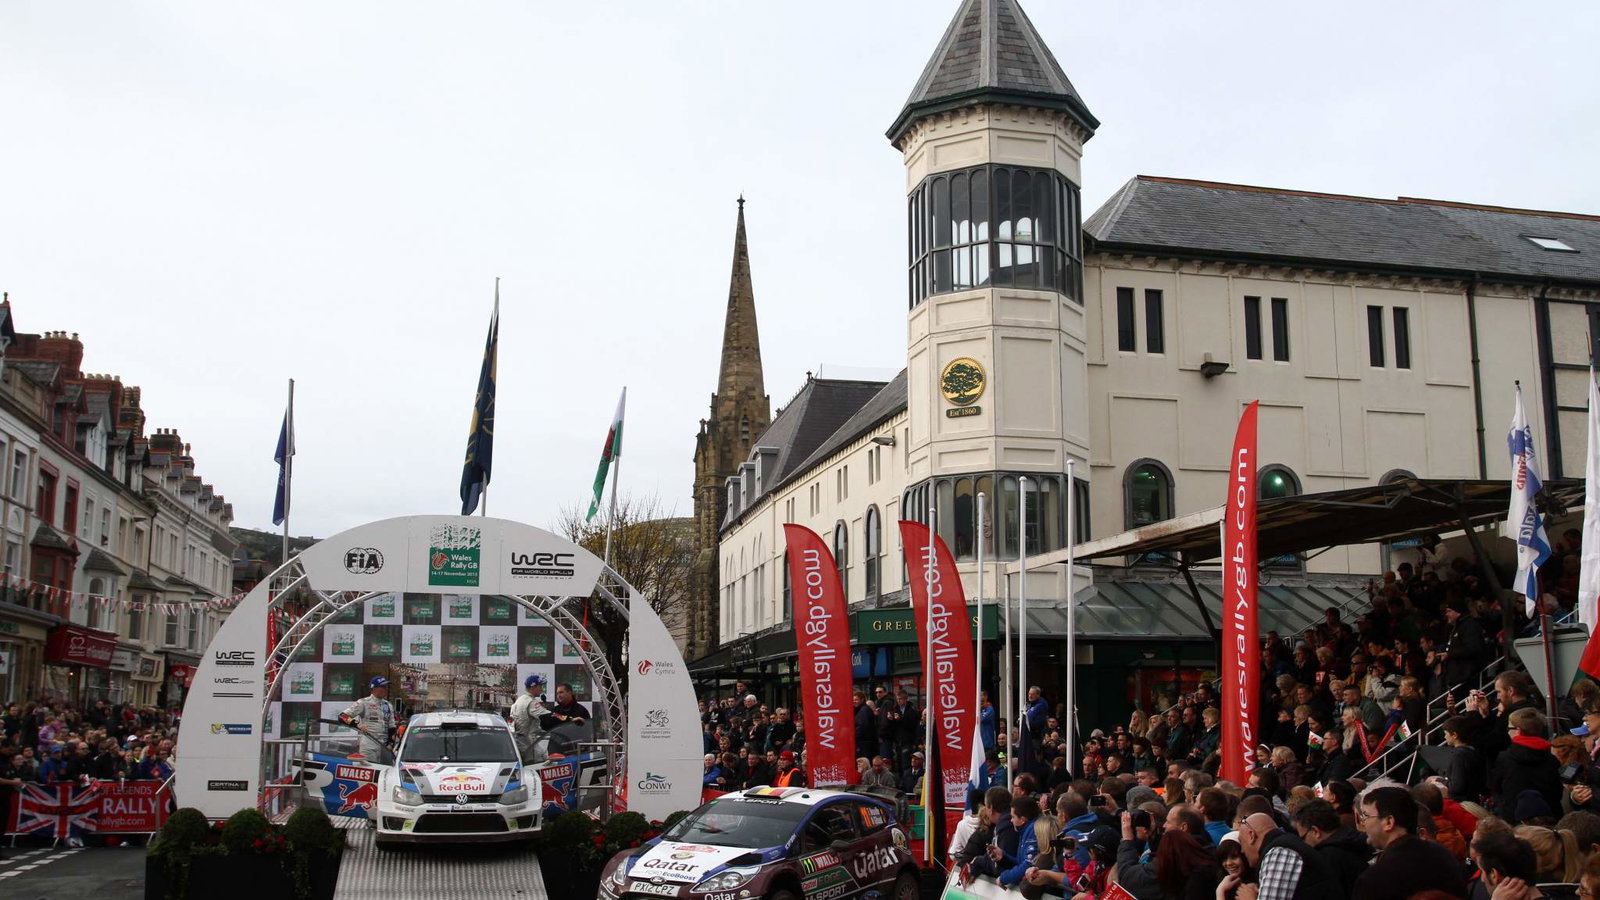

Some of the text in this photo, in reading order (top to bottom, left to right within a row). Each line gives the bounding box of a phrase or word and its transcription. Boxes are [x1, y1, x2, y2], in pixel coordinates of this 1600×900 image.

[961, 407, 977, 416] 1860
[511, 552, 574, 567] WRC
[450, 562, 467, 570] Rally
[1233, 448, 1256, 771] walesrallygb.com
[216, 651, 255, 660] WRC
[655, 669, 675, 677] Cymru
[340, 767, 371, 780] WALES
[543, 766, 570, 779] WALES
[439, 783, 485, 791] Red Bull
[638, 780, 672, 790] CONWY
[113, 786, 152, 795] LEGENDS
[103, 798, 157, 814] RALLY
[643, 858, 699, 873] Qatar
[803, 858, 815, 874] 11
[853, 844, 899, 879] Qatar
[662, 871, 696, 881] EcoBoost
[634, 883, 653, 892] PX12
